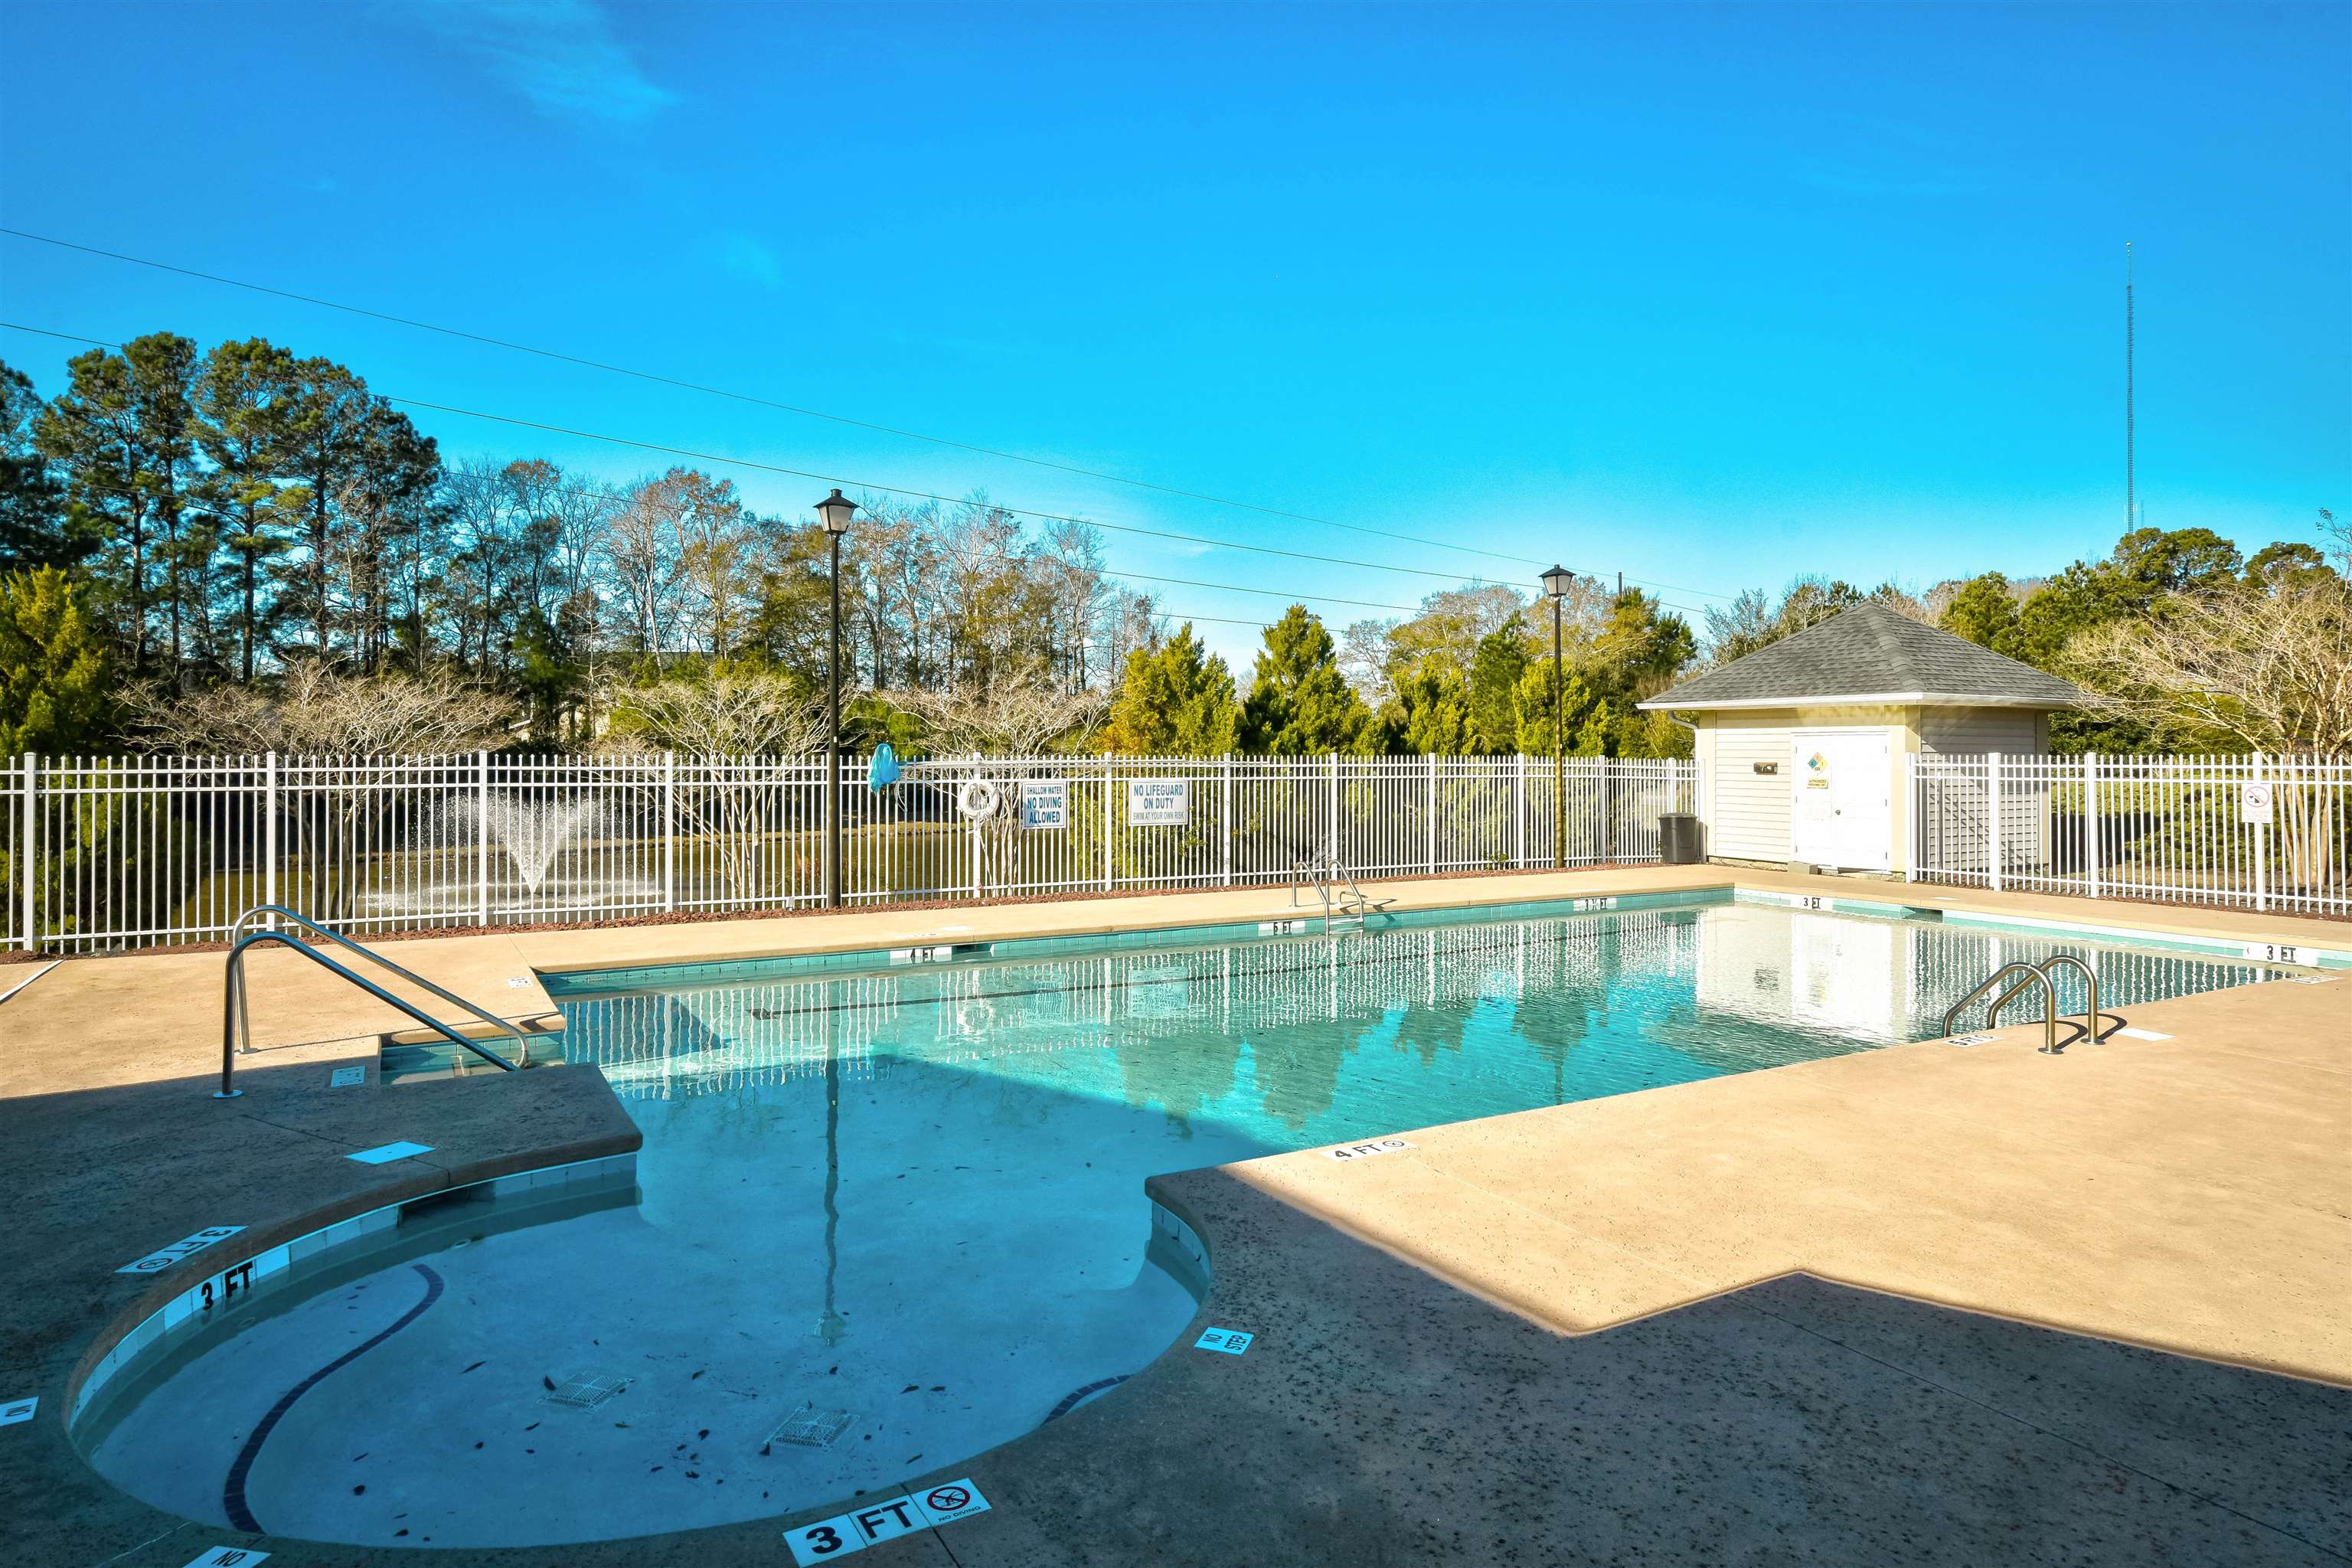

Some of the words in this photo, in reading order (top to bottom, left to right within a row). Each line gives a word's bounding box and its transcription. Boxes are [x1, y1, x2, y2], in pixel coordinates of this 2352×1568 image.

[1027, 786, 1047, 795] SHALLOW
[1047, 786, 1063, 795] WATER
[1134, 785, 1144, 796] NO
[1145, 784, 1184, 796] LIFEGUARD
[1027, 797, 1037, 808] NO
[1039, 796, 1062, 808] DIVING
[1144, 797, 1153, 809] ON
[1155, 797, 1174, 809] DUTY
[1029, 811, 1060, 824] ALLOWED
[1152, 812, 1163, 820] YOUR
[1164, 812, 1174, 820] OWN
[1174, 811, 1184, 819] RISK
[1351, 1144, 1382, 1155] FT
[163, 1242, 211, 1254] FT
[201, 1282, 214, 1311] 3
[225, 1261, 253, 1298] FT
[1202, 1334, 1223, 1344] NO
[1224, 1334, 1248, 1351] STEP
[952, 1506, 982, 1517] DIVING
[805, 1527, 843, 1554] 3
[857, 1501, 913, 1539] FT
[211, 1550, 247, 1567] NO
